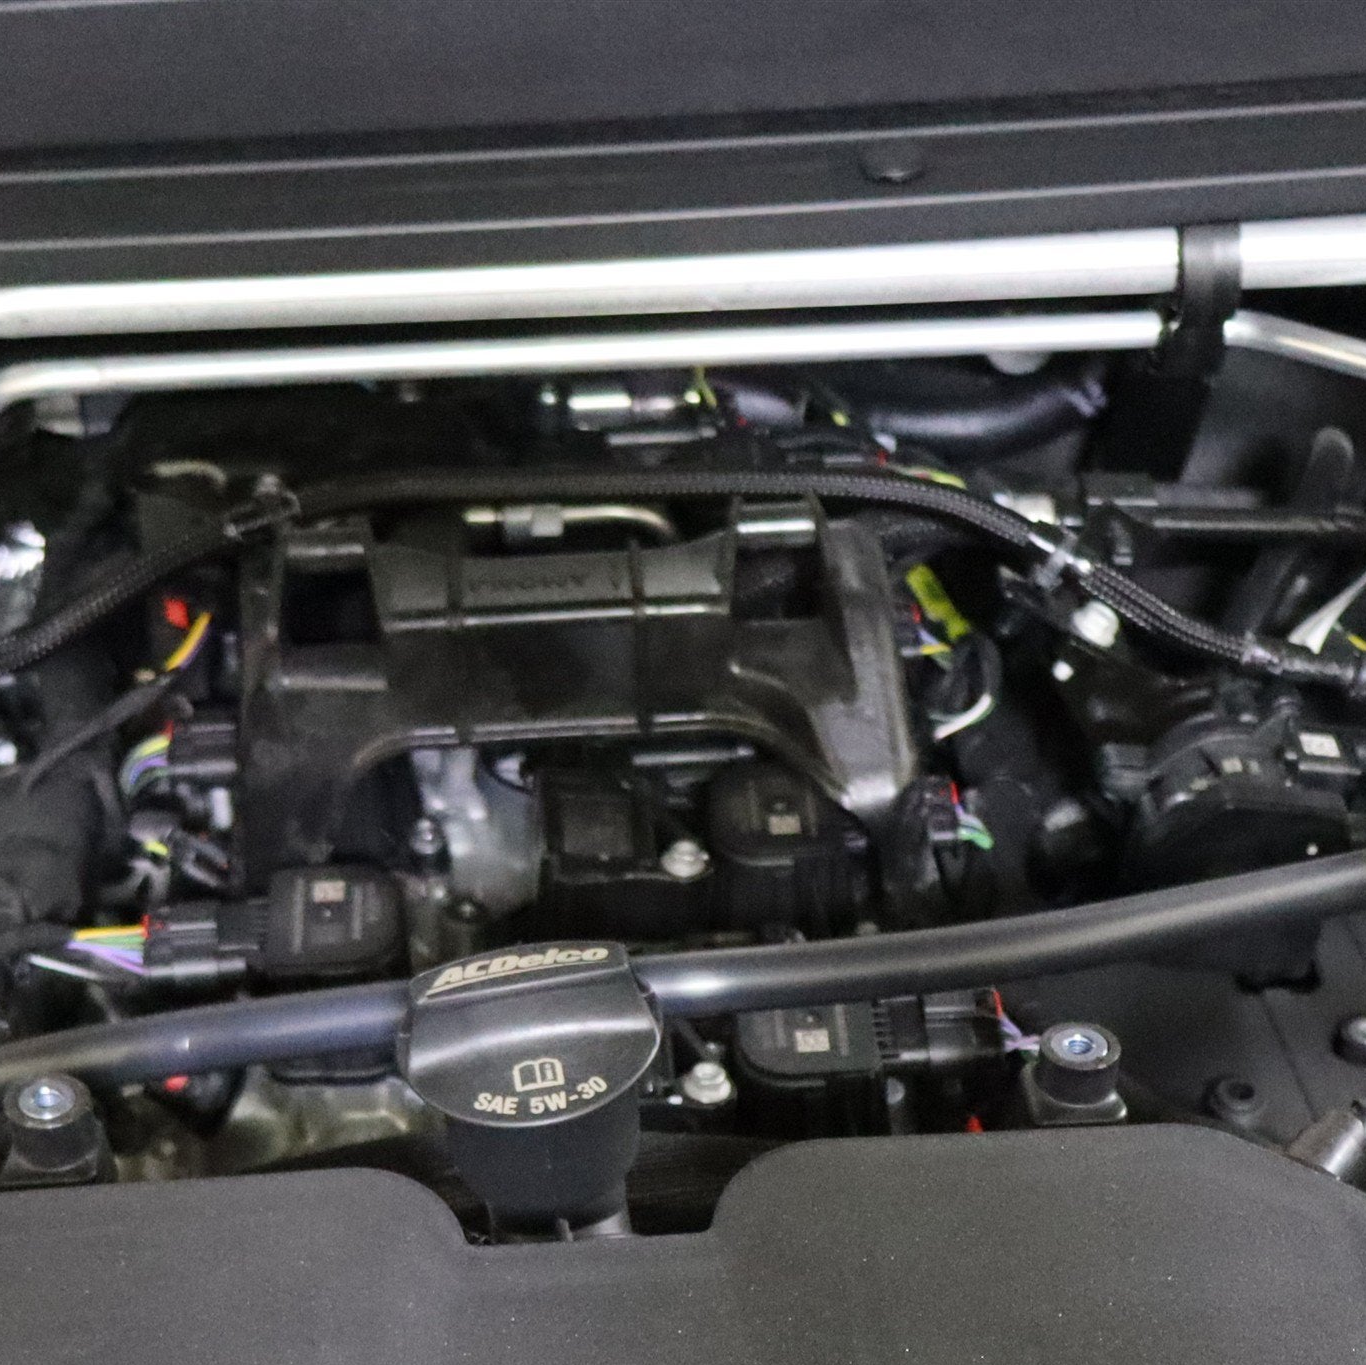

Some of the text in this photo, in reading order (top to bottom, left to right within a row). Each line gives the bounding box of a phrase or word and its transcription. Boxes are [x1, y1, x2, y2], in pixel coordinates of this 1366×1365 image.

[431, 946, 609, 989] ACDelco
[473, 1075, 608, 1116] SAE 5W-30
